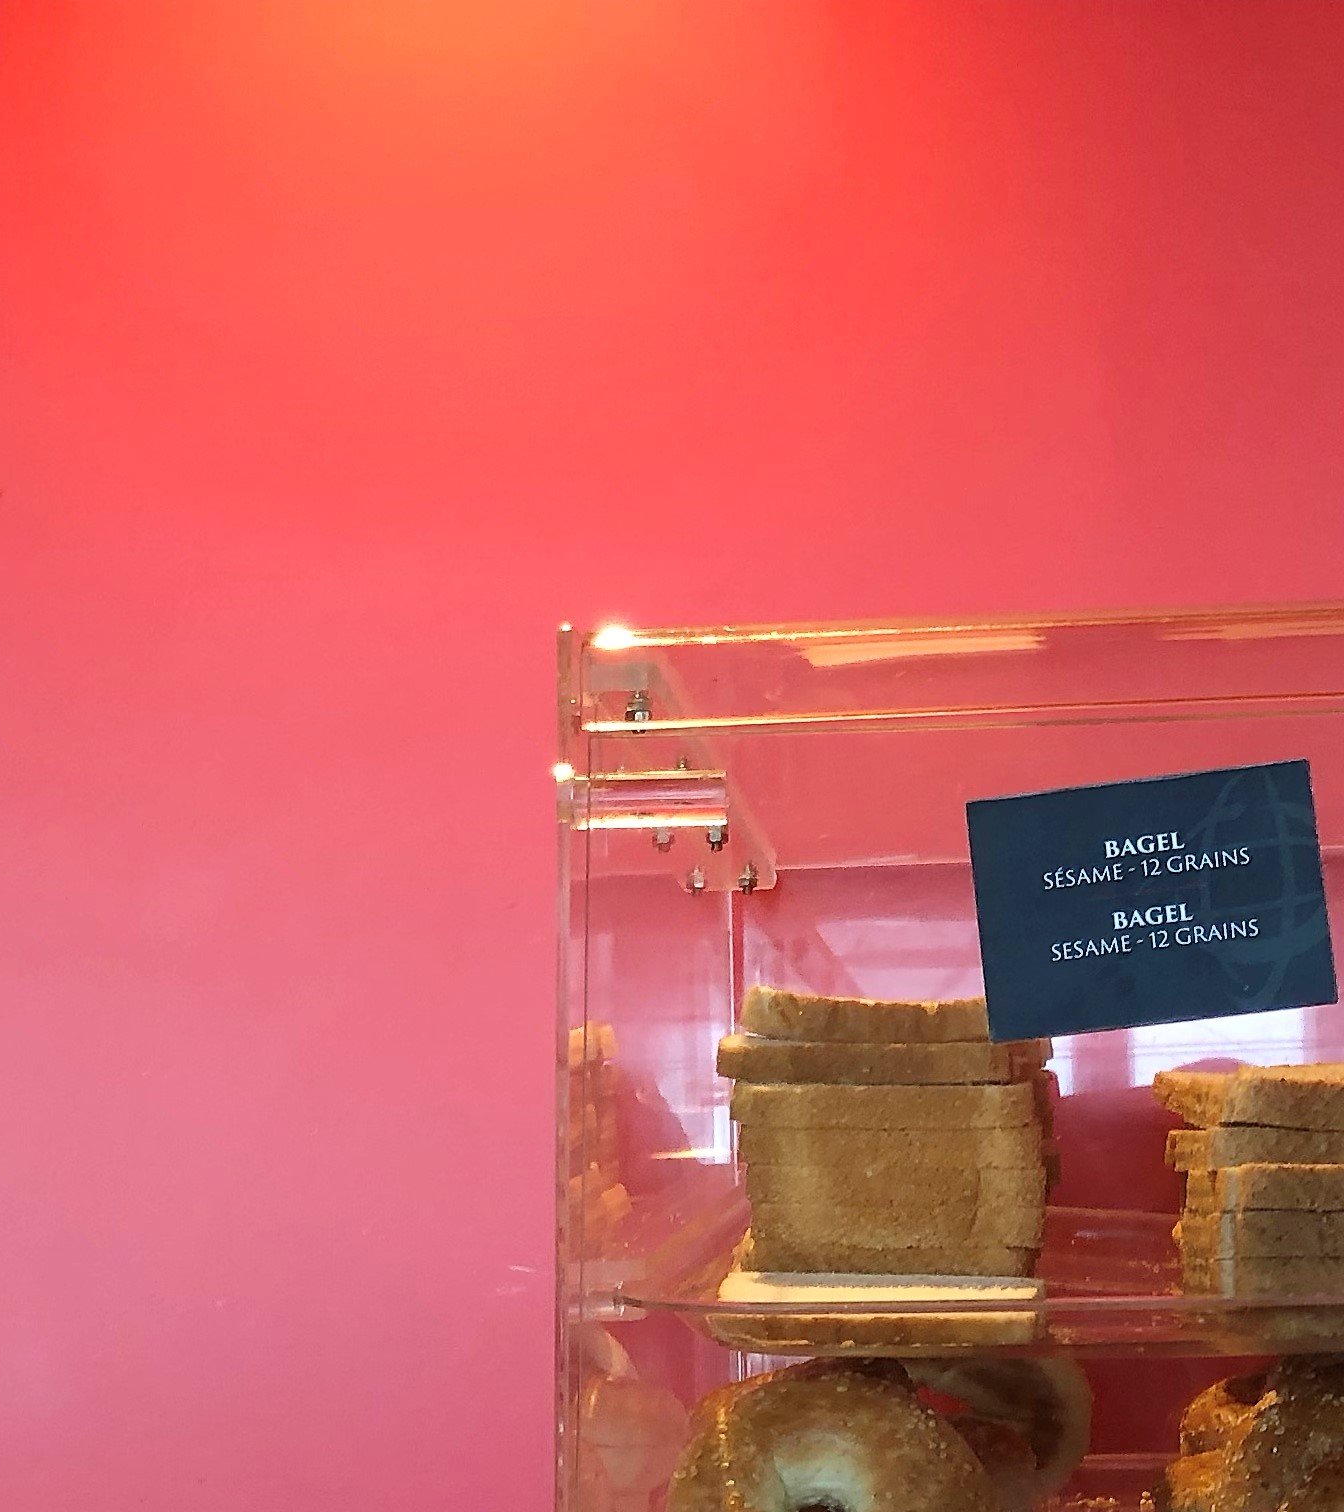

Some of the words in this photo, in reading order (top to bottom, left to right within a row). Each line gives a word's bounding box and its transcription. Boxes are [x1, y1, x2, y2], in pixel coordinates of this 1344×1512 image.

[1104, 831, 1185, 859] BAGEL
[1043, 863, 1124, 890] SÉSAME
[1141, 858, 1162, 877] 12
[1166, 847, 1251, 875] GRAINS
[1112, 903, 1194, 931] BAGEL
[1051, 934, 1132, 962] SESAME
[1149, 930, 1170, 950] 12
[1175, 919, 1260, 946] GRAINS
